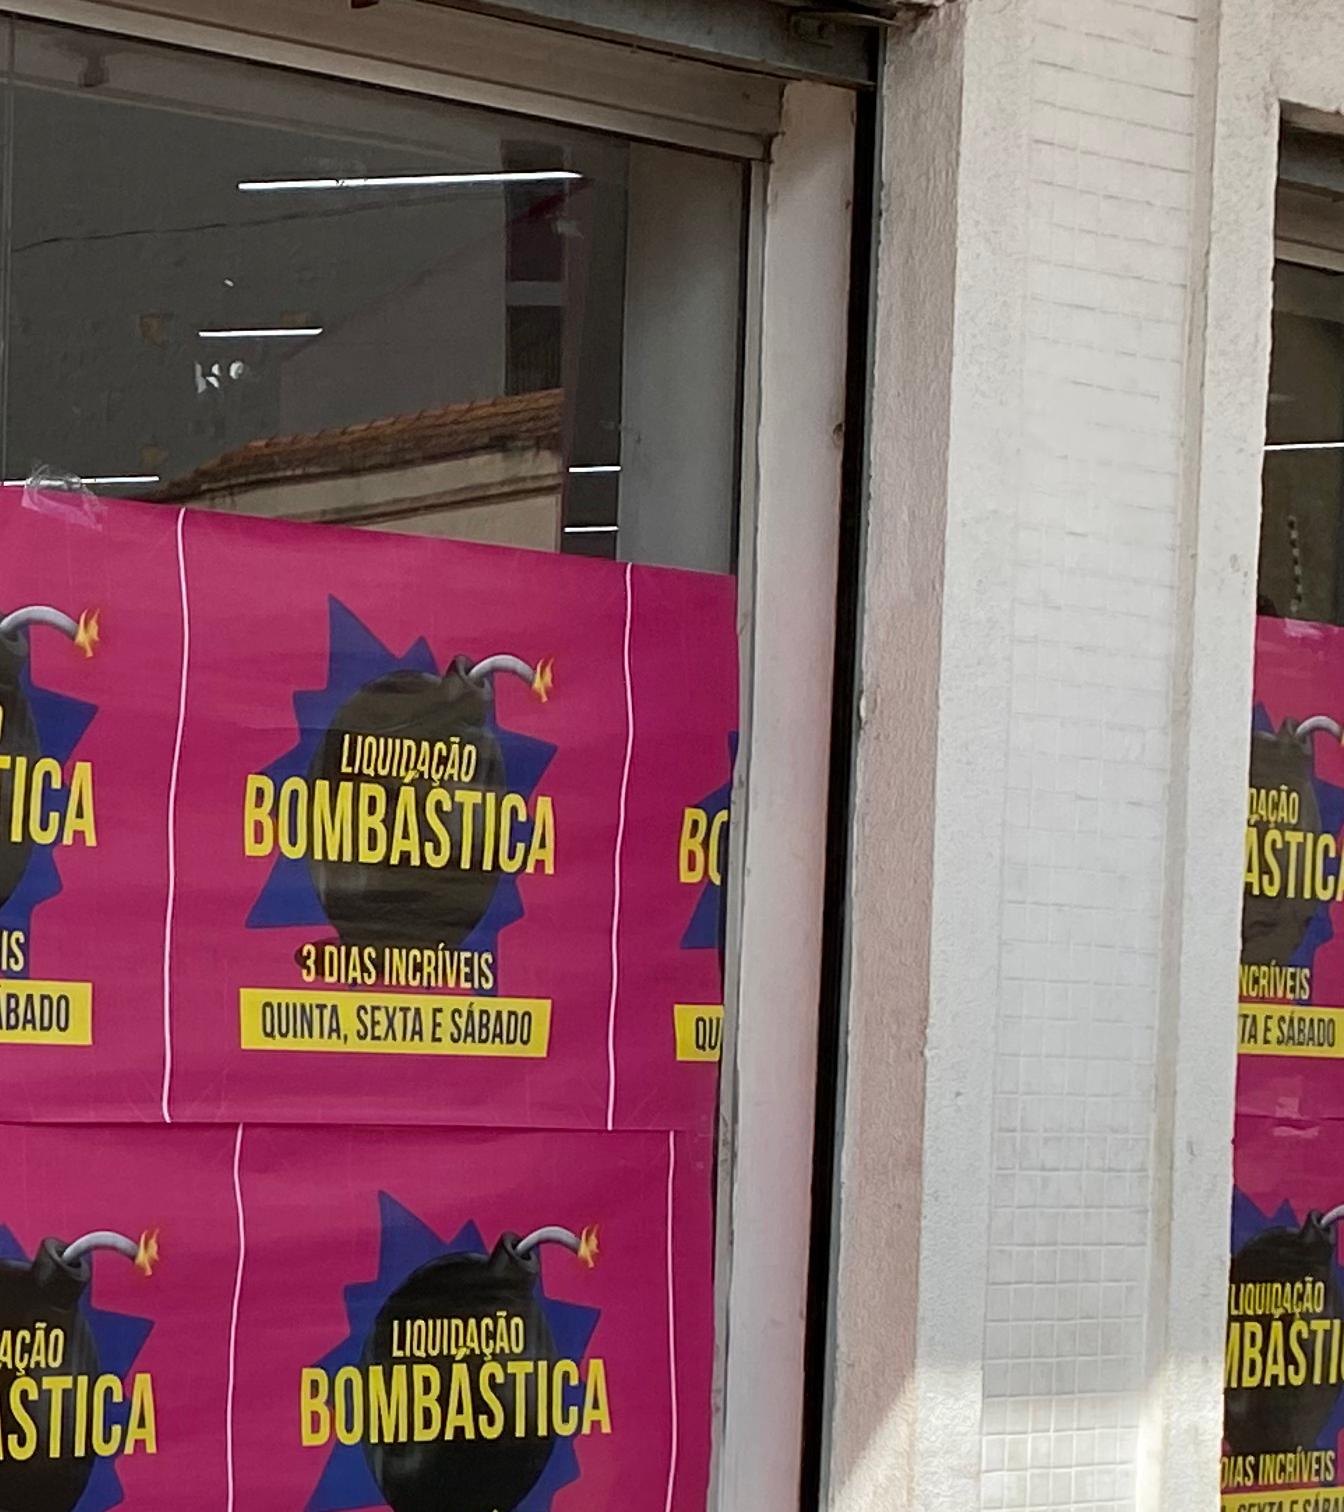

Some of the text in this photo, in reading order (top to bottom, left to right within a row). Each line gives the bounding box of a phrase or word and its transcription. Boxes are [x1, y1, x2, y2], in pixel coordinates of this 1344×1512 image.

[341, 734, 477, 786] LIQUIDAÇÃO
[244, 770, 555, 875] BOMBÁSTICA
[1250, 784, 1299, 828] DAÇÃO
[1245, 814, 1344, 901] ÁSTIC
[301, 943, 494, 990] 3 DIAS INCRÍVEIS
[1239, 960, 1310, 1000] NCRÍVEIS
[262, 1002, 532, 1046] QUINTA, SEXTA E SÁBADO
[1263, 1015, 1273, 1044] E
[1277, 1011, 1335, 1048] SÁBADO
[1231, 1276, 1325, 1318] LIQUIDAÇÃO
[392, 1311, 524, 1361] LIQUIDAÇÃO
[301, 1347, 612, 1447] BOMBÁSTICA
[1221, 1446, 1335, 1489] DIAS INCRÍVEIS
